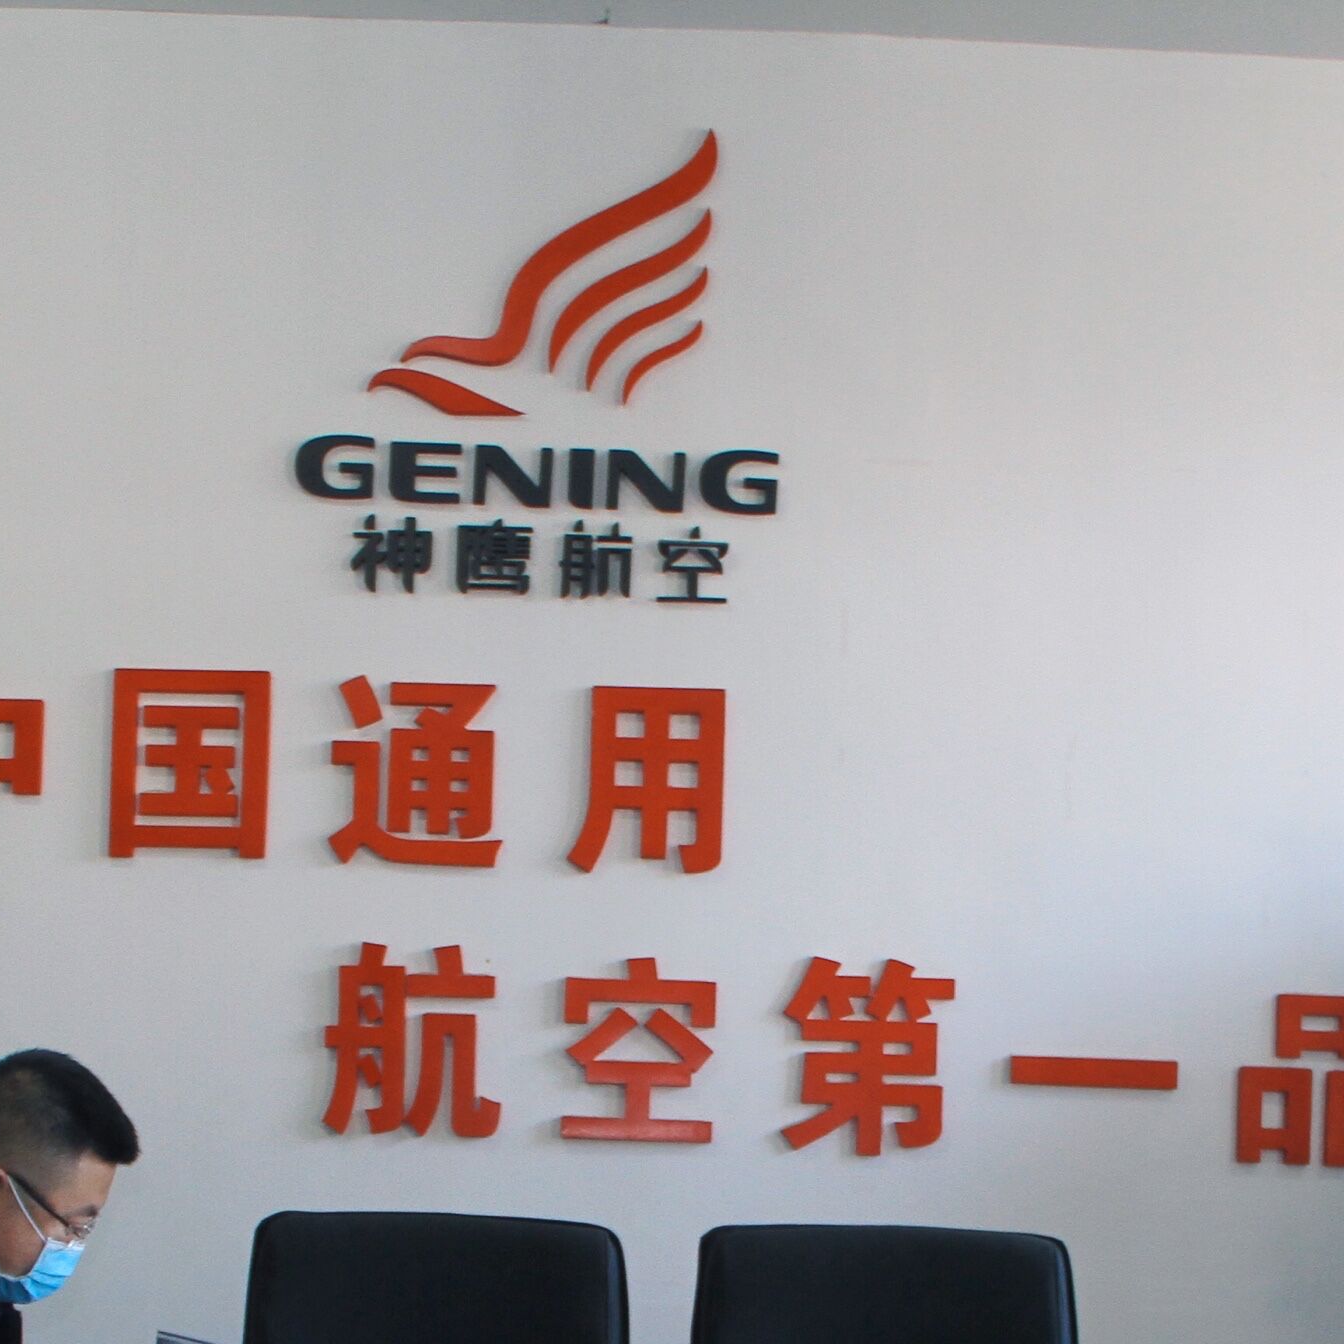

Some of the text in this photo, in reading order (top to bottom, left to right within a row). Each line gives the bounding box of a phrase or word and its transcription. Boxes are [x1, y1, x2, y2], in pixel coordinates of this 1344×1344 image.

[294, 433, 781, 517] GENING
[350, 513, 729, 605] 神鹰航空
